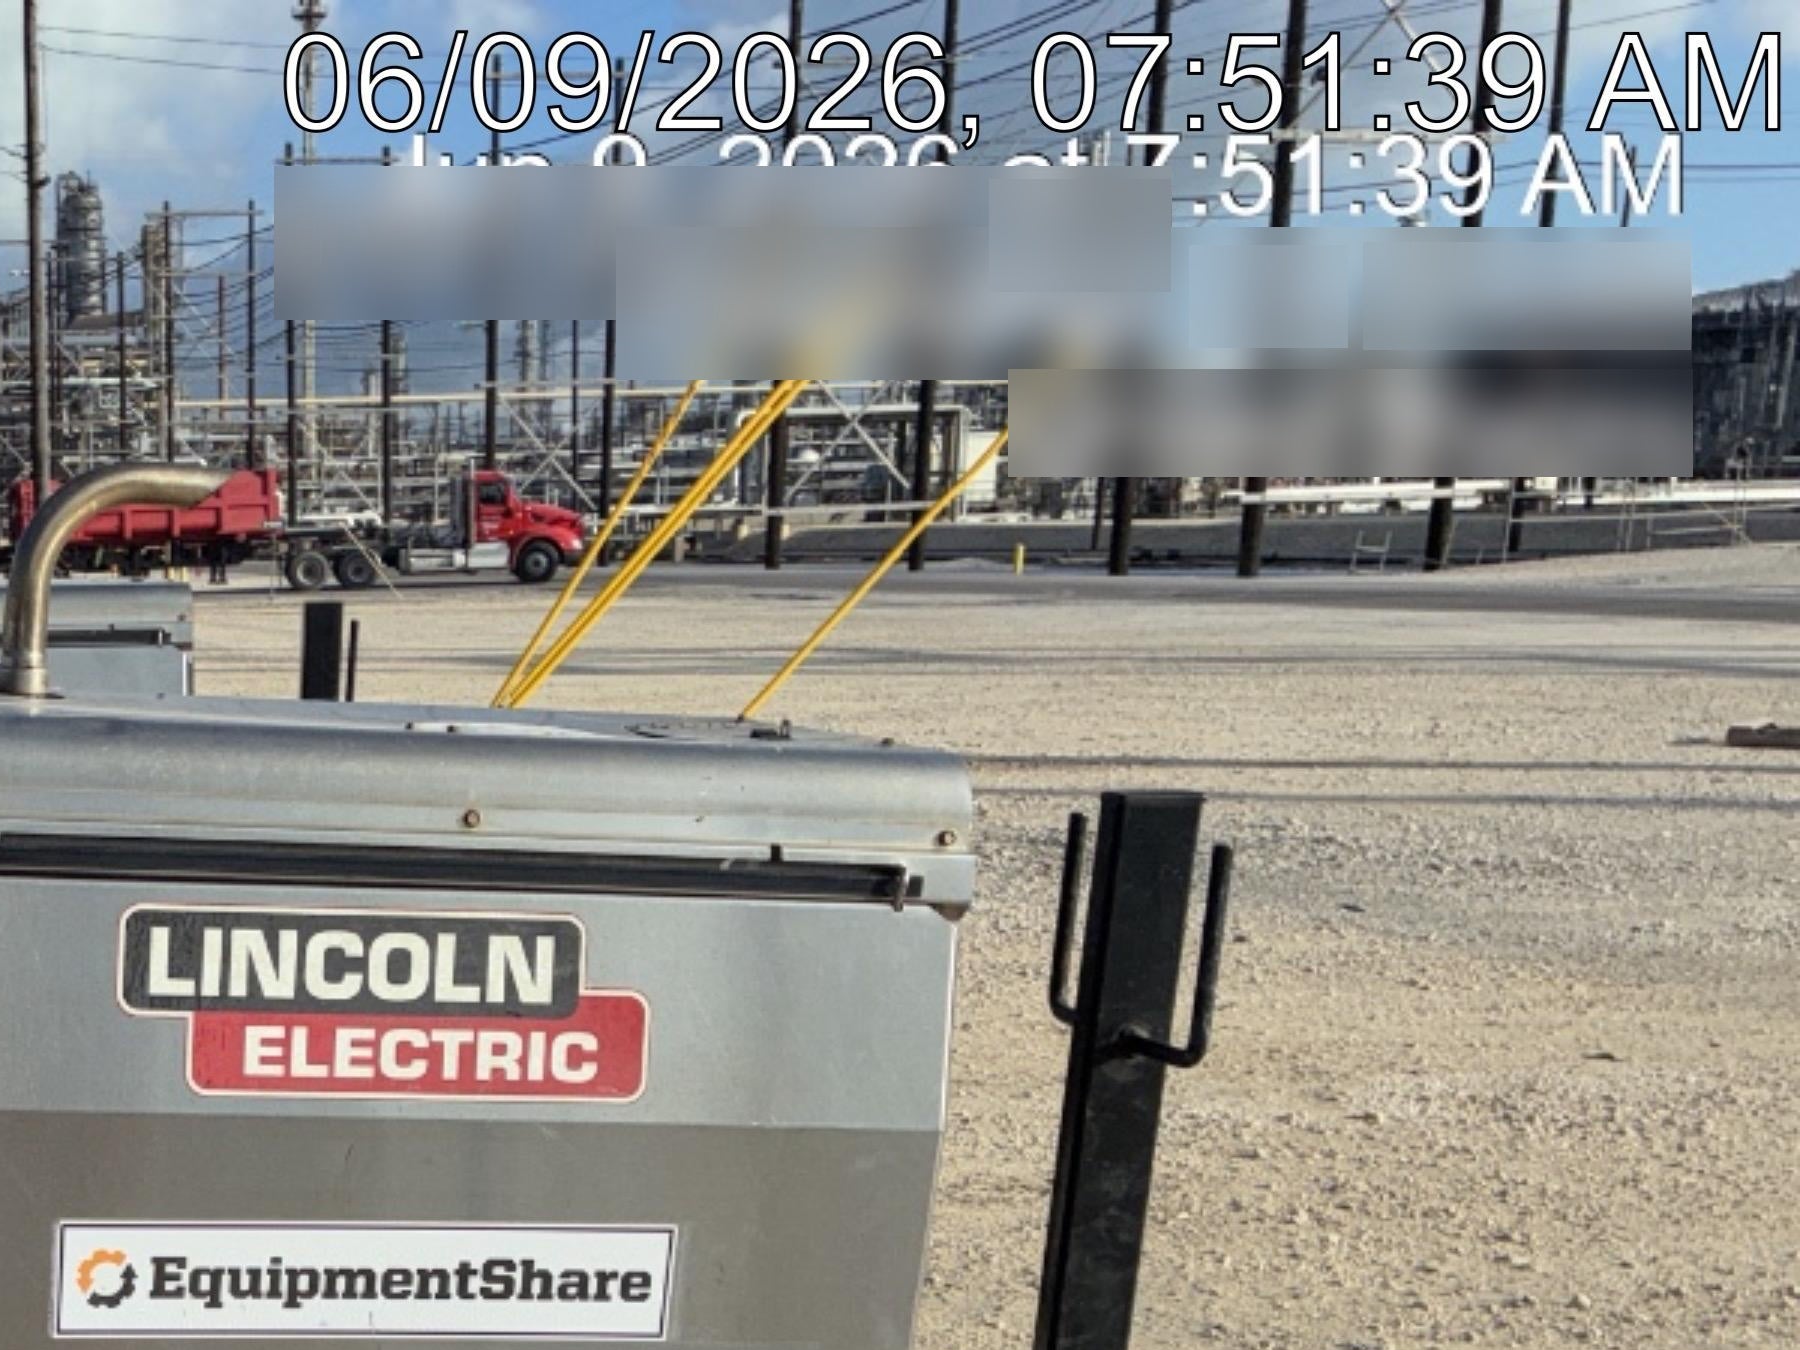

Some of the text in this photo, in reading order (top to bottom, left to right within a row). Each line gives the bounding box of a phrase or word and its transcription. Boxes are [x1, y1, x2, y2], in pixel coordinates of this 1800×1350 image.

[147, 926, 556, 1005] LINCOLN
[242, 1025, 599, 1083] ELECTRIC
[149, 1256, 652, 1309] EquipmentShare
